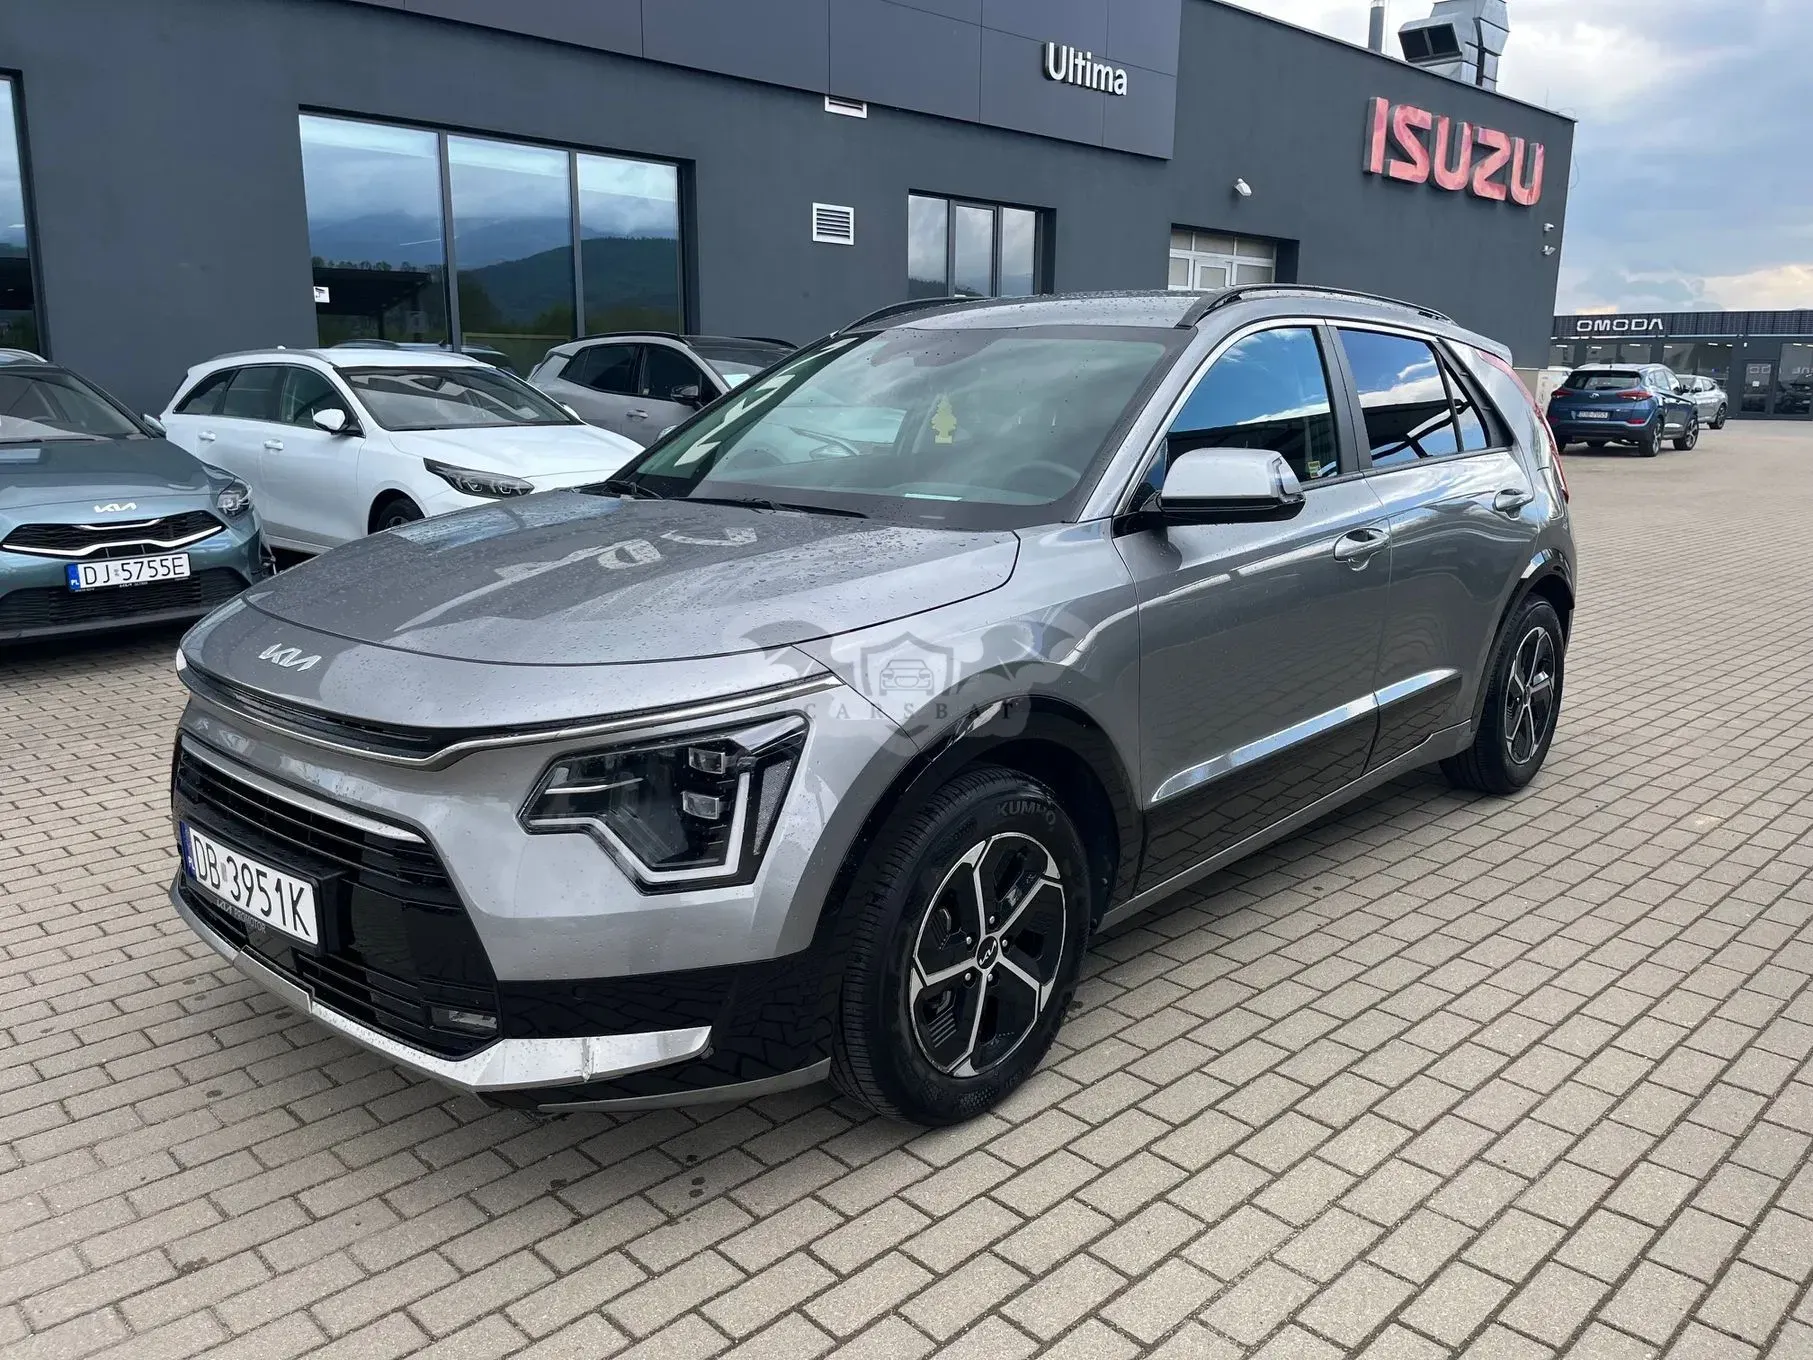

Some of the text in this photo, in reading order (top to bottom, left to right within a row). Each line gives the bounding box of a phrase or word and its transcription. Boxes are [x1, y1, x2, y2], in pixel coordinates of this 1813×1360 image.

[1046, 41, 1128, 96] Ultima
[1364, 96, 1545, 206] ISUZU
[1576, 318, 1664, 332] OMODA
[94, 502, 137, 513] KIA
[83, 556, 185, 586] DJ 5755E
[258, 642, 322, 673] KIA
[193, 834, 311, 937] DB 3951K
